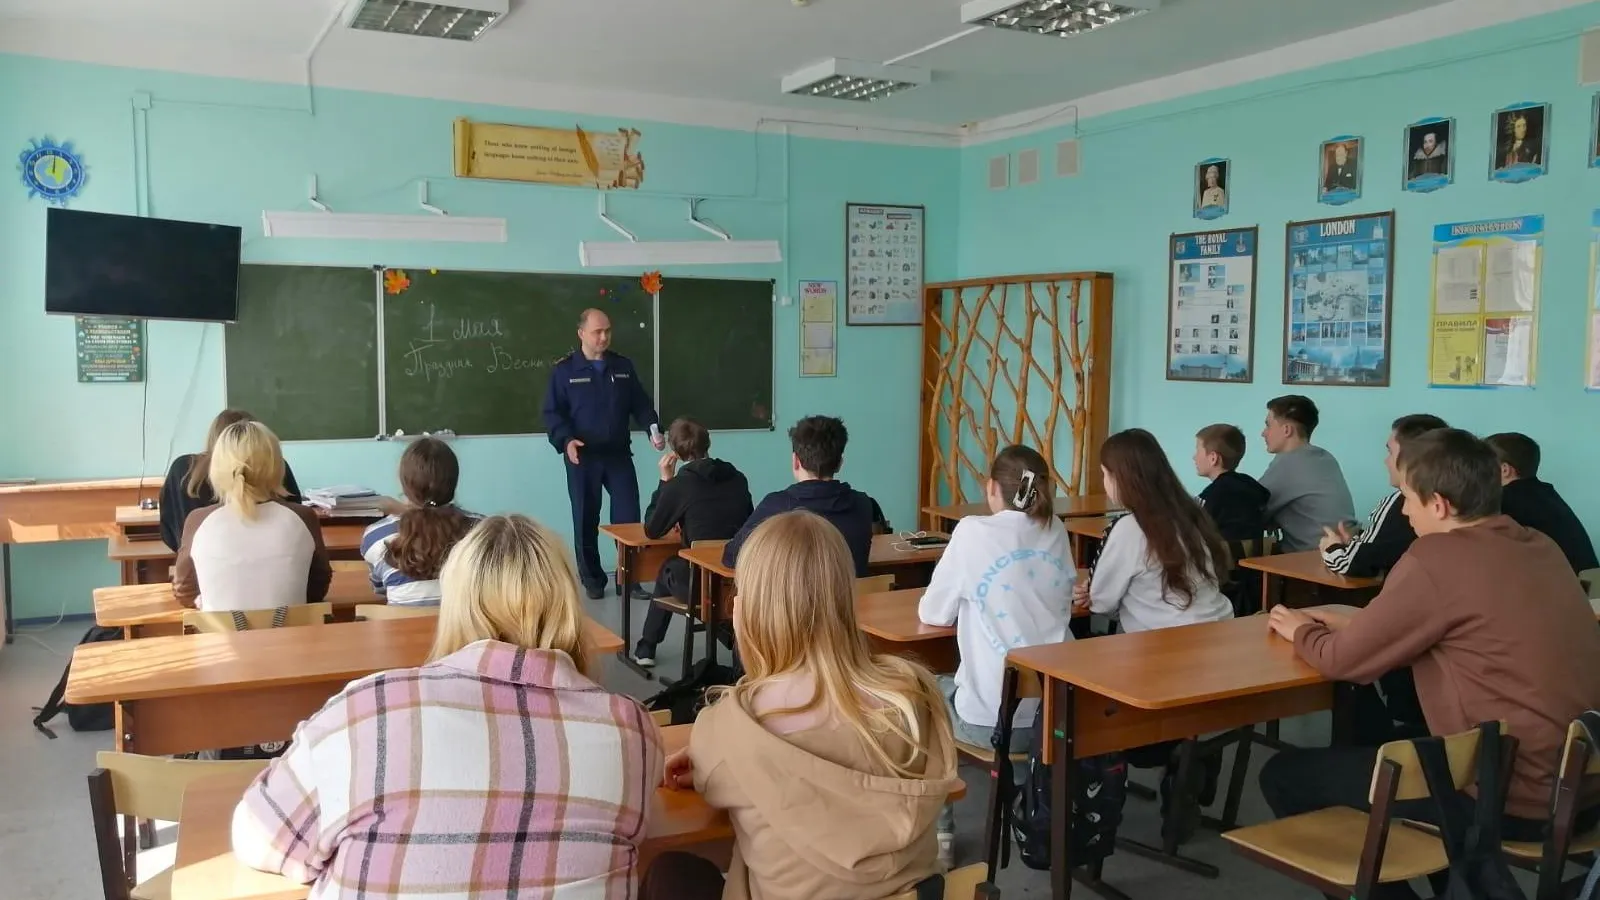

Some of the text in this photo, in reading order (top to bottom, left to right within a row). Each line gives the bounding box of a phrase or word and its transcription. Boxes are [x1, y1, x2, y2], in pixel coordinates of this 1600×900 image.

[1320, 219, 1356, 237] LONDON
[1451, 219, 1523, 236] INFORMATION
[1195, 232, 1228, 245] THE ROYAL
[1200, 243, 1221, 256] FAMILY
[1436, 320, 1478, 328] ПРАВИЛА
